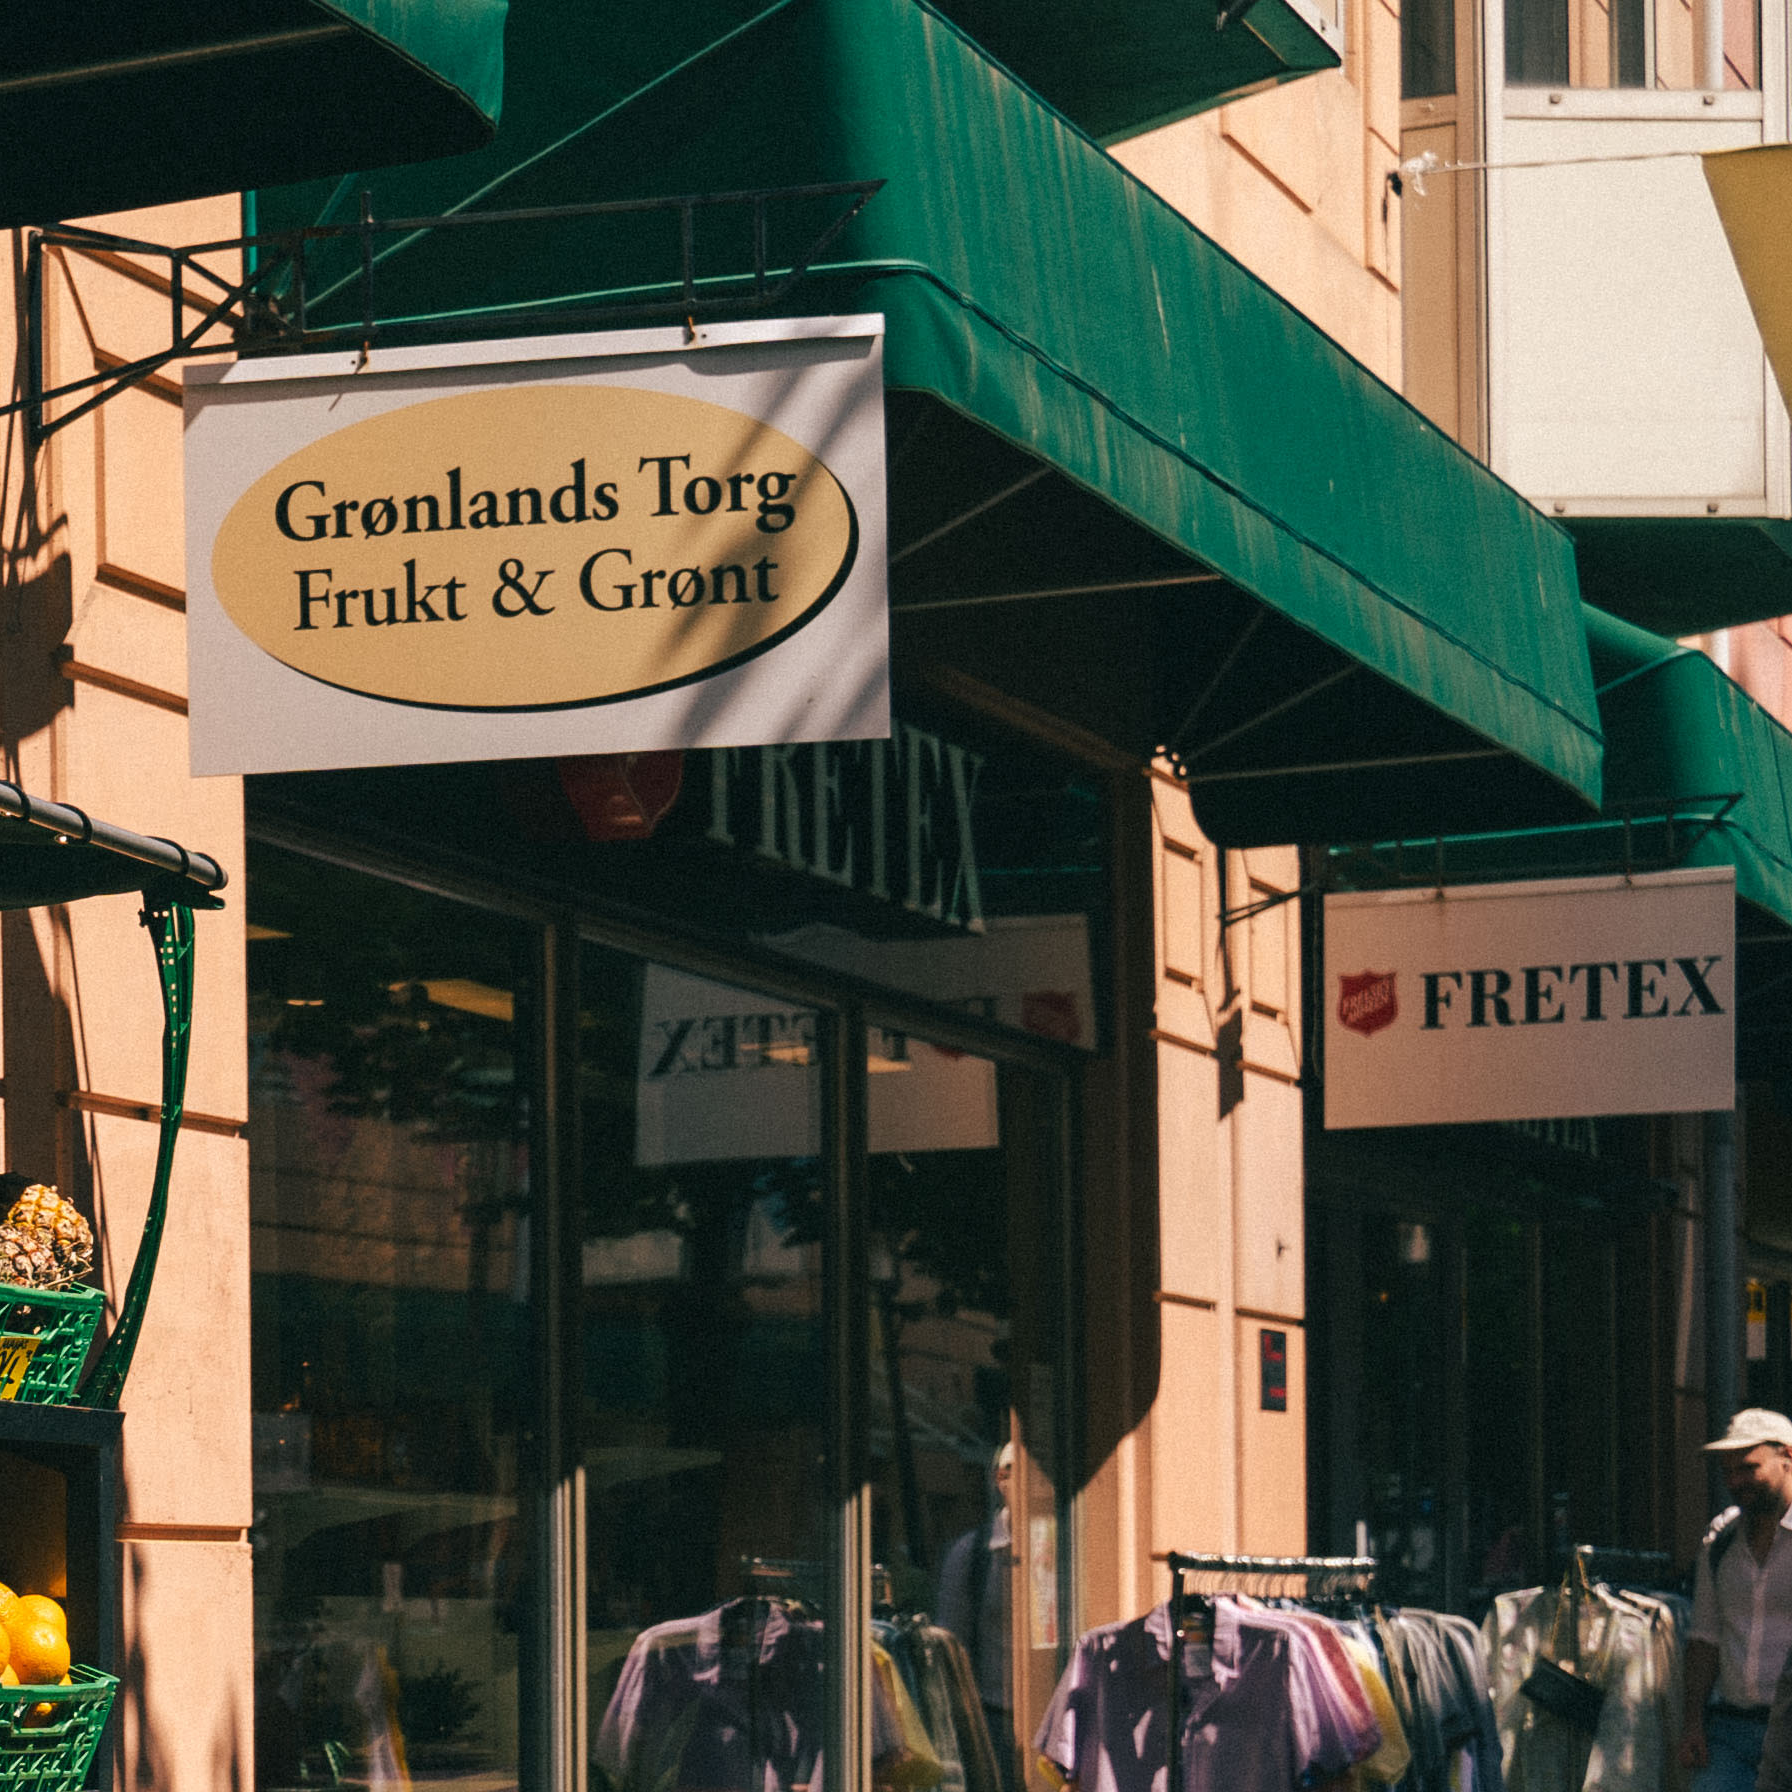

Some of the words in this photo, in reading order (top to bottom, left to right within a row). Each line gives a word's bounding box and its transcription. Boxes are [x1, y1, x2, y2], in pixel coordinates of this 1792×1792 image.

[275, 458, 619, 543] Grønlands
[638, 454, 797, 534] Torg
[292, 559, 467, 632] Frukt
[492, 557, 555, 619] &
[579, 547, 780, 613] Grønt
[1419, 954, 1726, 1031] FRETEX
